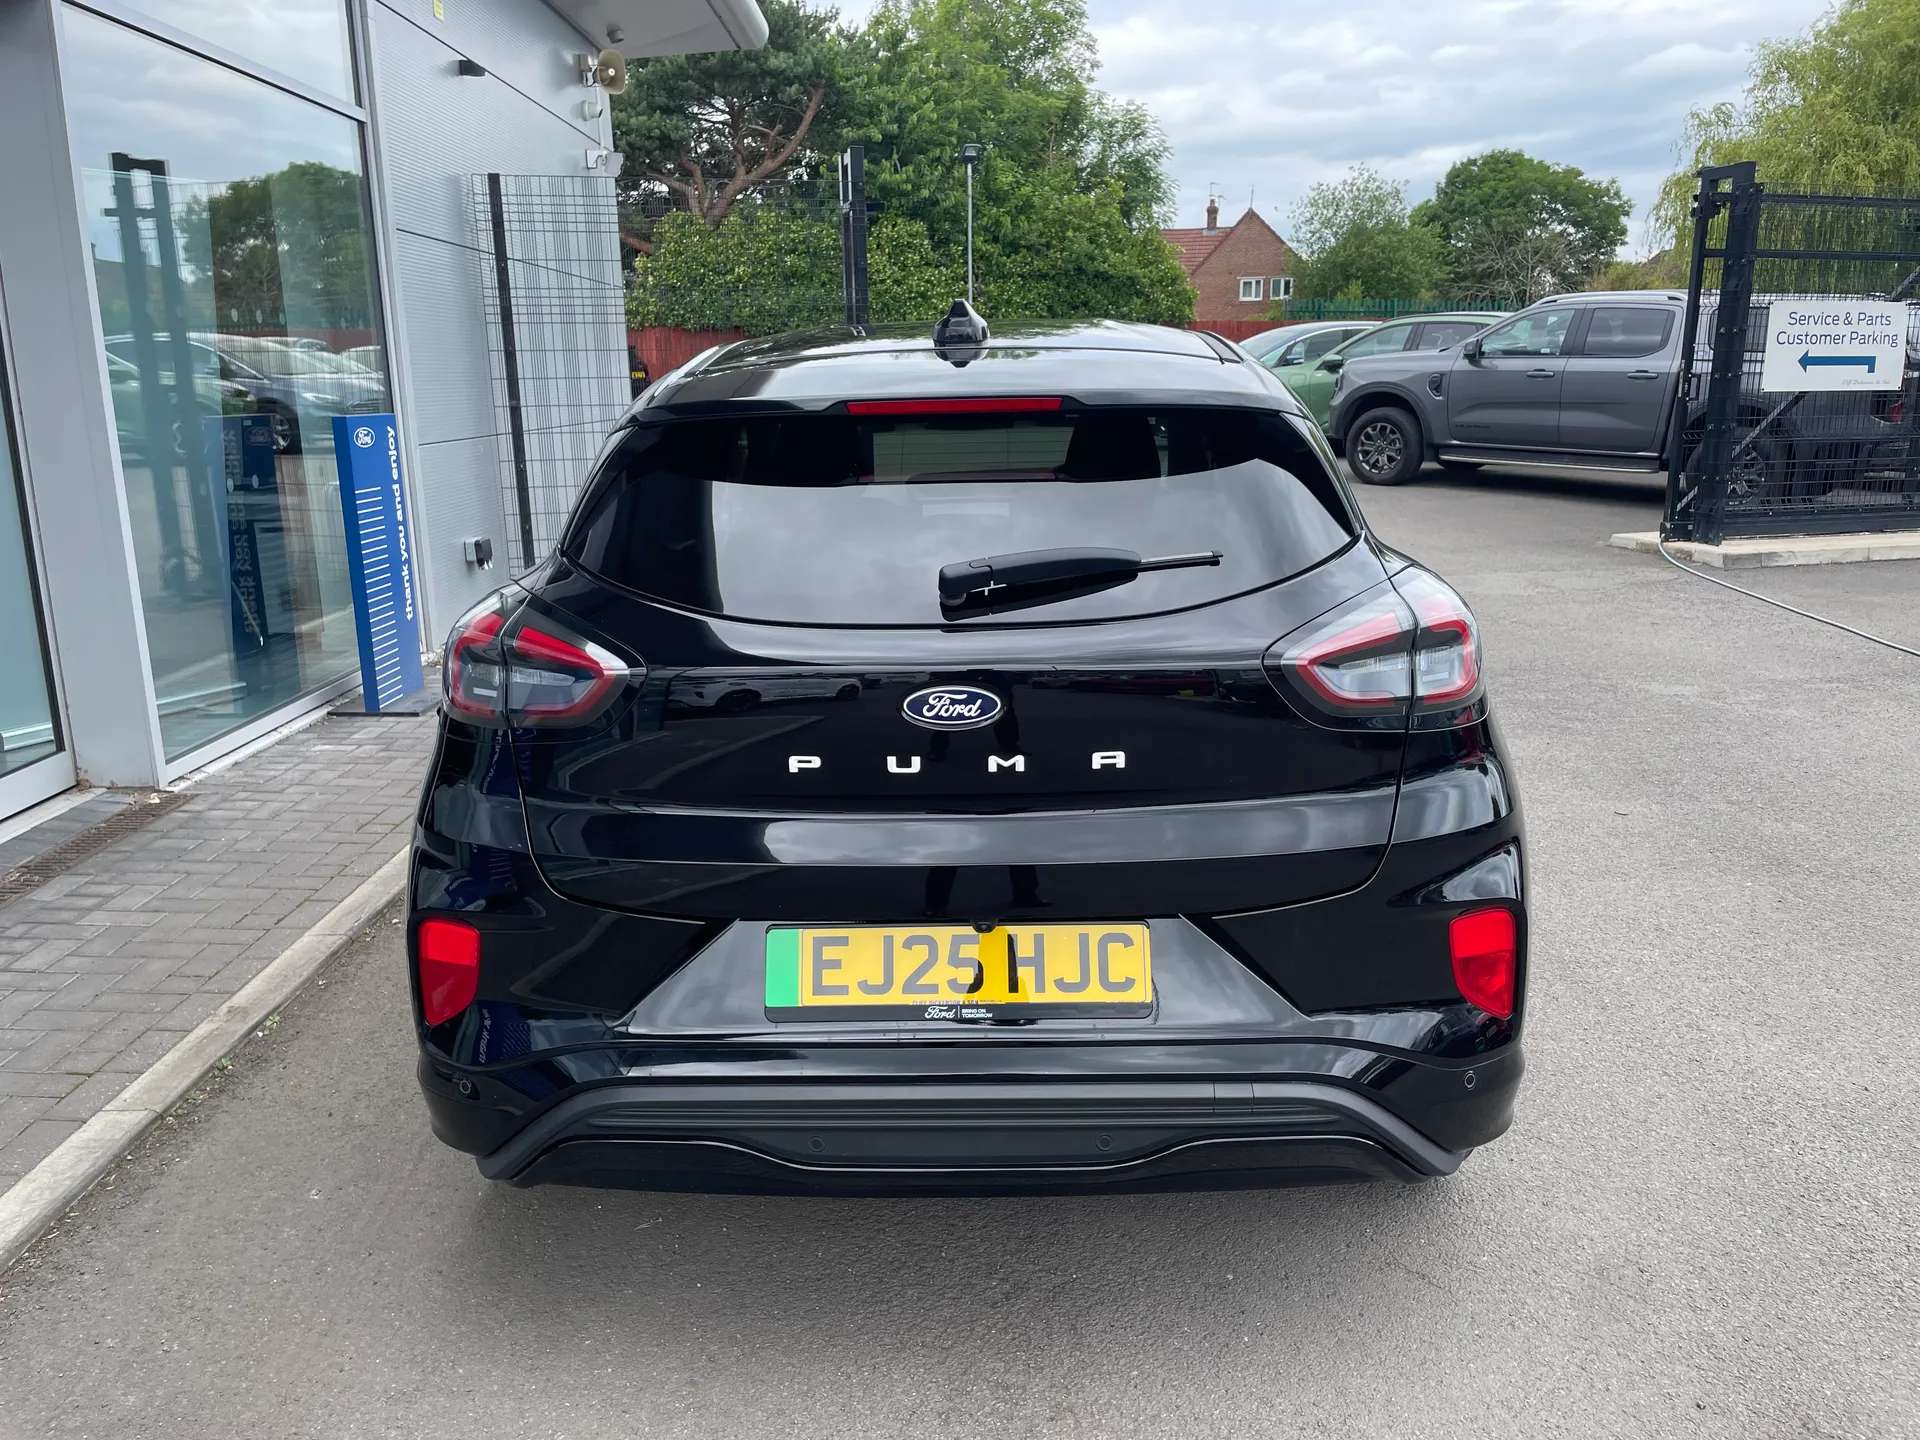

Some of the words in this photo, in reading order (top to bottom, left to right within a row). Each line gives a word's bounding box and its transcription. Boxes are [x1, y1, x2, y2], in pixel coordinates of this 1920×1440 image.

[1788, 312, 1840, 326] Service
[1843, 312, 1854, 326] &
[1857, 312, 1892, 326] Parts
[1776, 331, 1846, 345] Customer
[1850, 331, 1899, 347] Parking
[387, 425, 398, 480] enjoy
[392, 483, 403, 521] and
[398, 525, 408, 561] you
[401, 564, 413, 621] thank
[922, 692, 982, 718] Ford
[788, 751, 1125, 773] PUMA
[812, 934, 984, 996] EJ25
[1007, 932, 1136, 994] HJC
[924, 1005, 956, 1019] Ford
